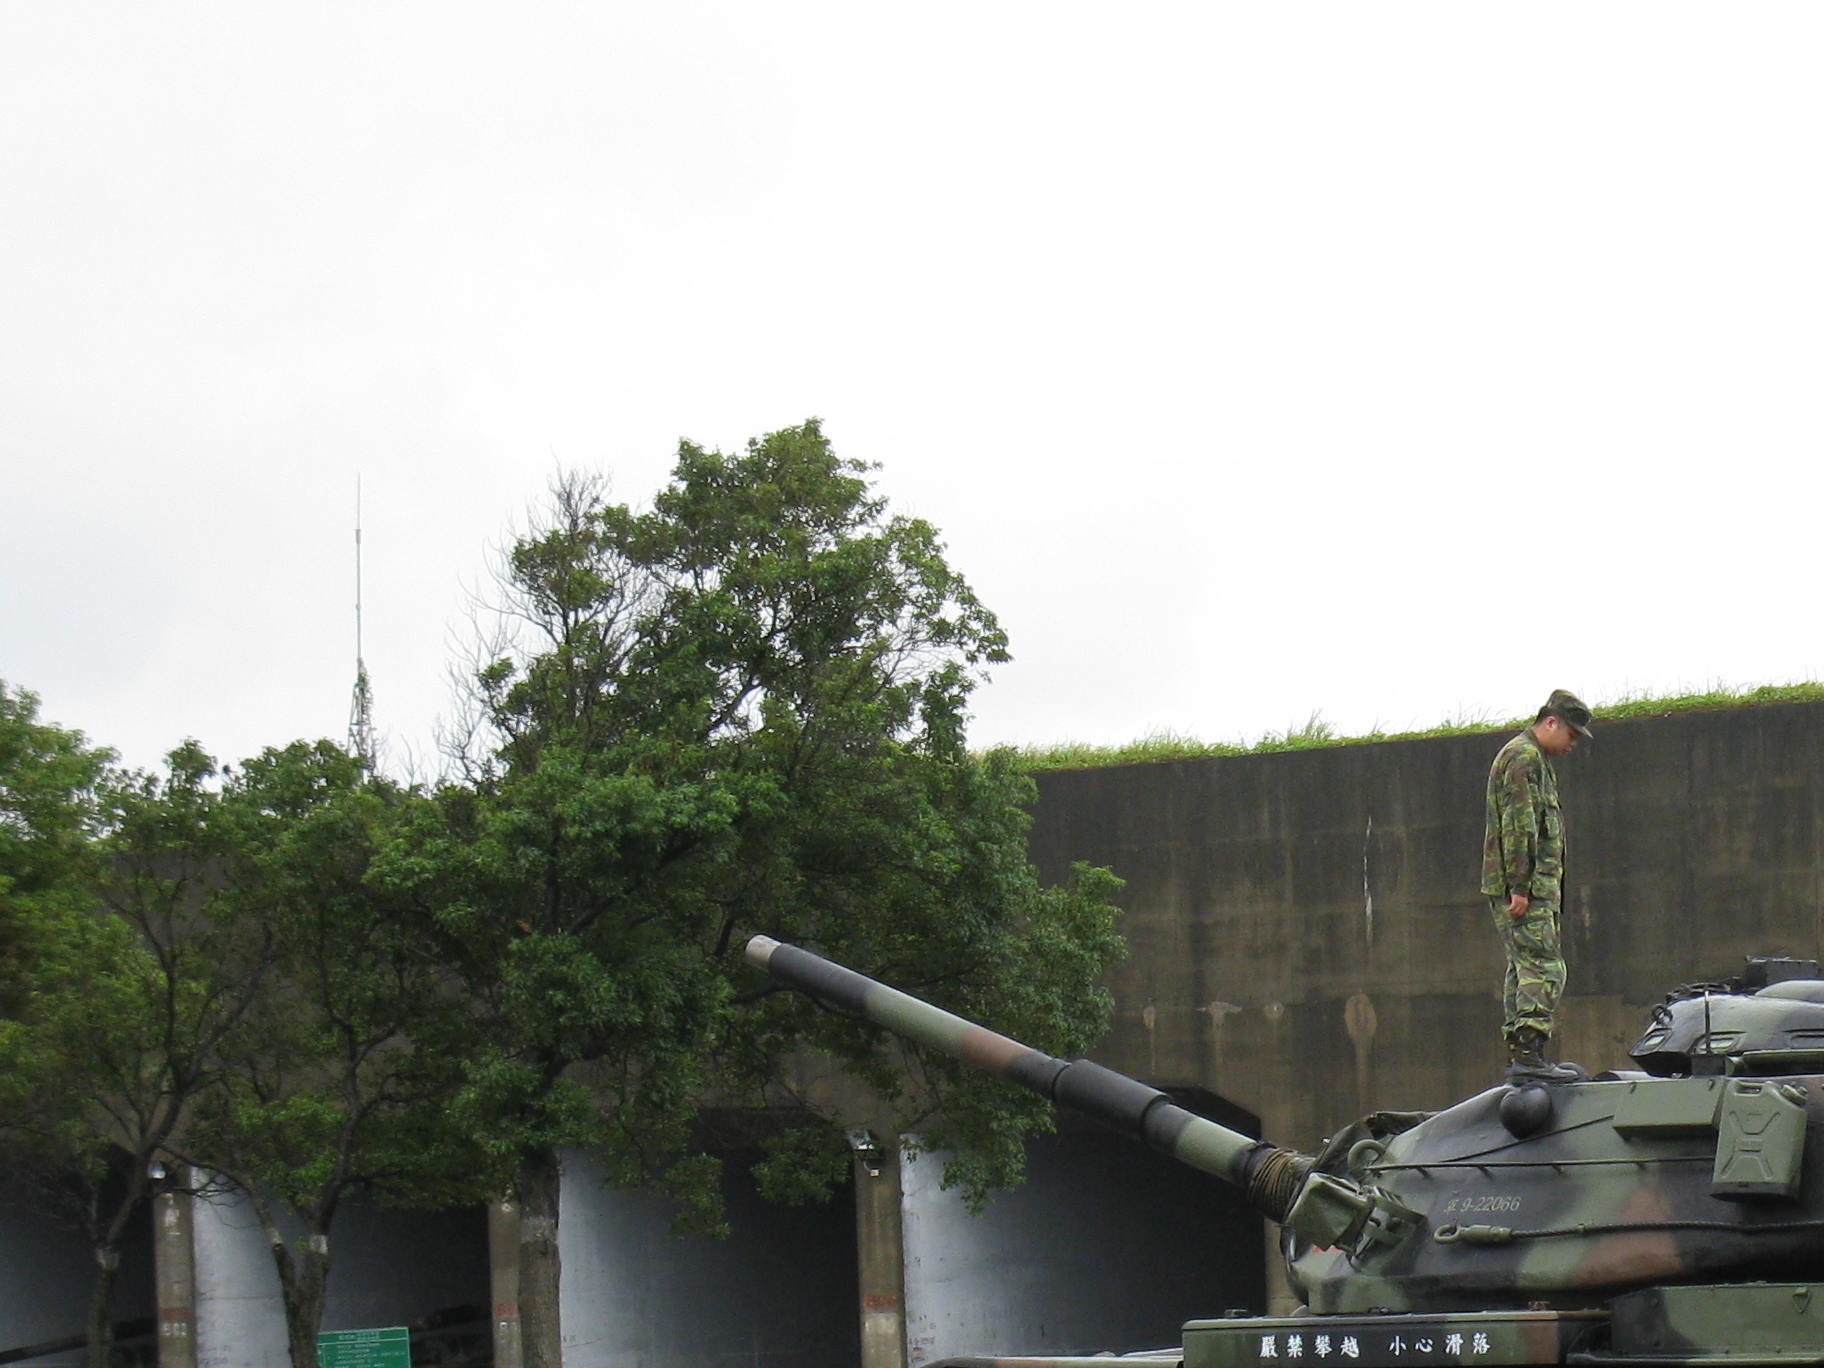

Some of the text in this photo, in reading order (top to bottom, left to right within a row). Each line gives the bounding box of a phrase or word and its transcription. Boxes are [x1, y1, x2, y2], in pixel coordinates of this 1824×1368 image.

[1460, 1196, 1522, 1212] 9-22066
[1259, 1332, 1490, 1358] 嚴禁攀越 小心滑落
